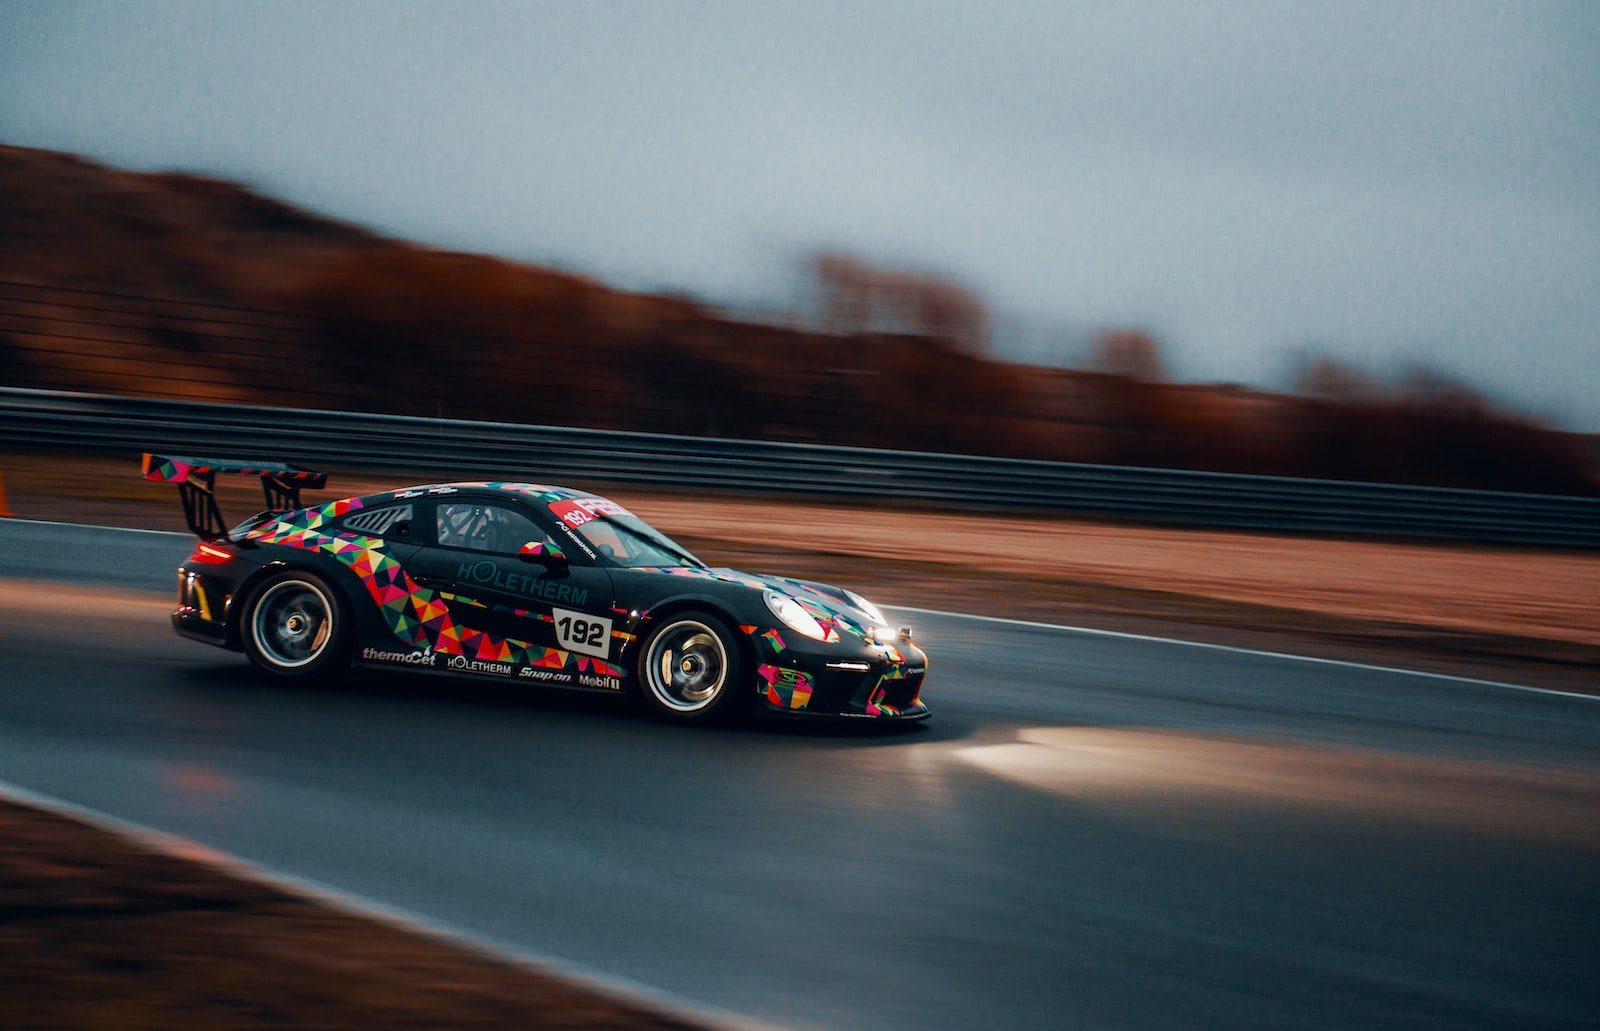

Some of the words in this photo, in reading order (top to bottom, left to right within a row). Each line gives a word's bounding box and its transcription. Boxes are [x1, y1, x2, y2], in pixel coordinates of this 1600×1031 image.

[563, 509, 592, 526] 192
[457, 560, 588, 605] HOLETHERM
[558, 617, 604, 648] 192
[447, 655, 512, 675] HOLETHERM
[519, 667, 571, 682] Snap-on
[579, 674, 610, 689] Mobil
